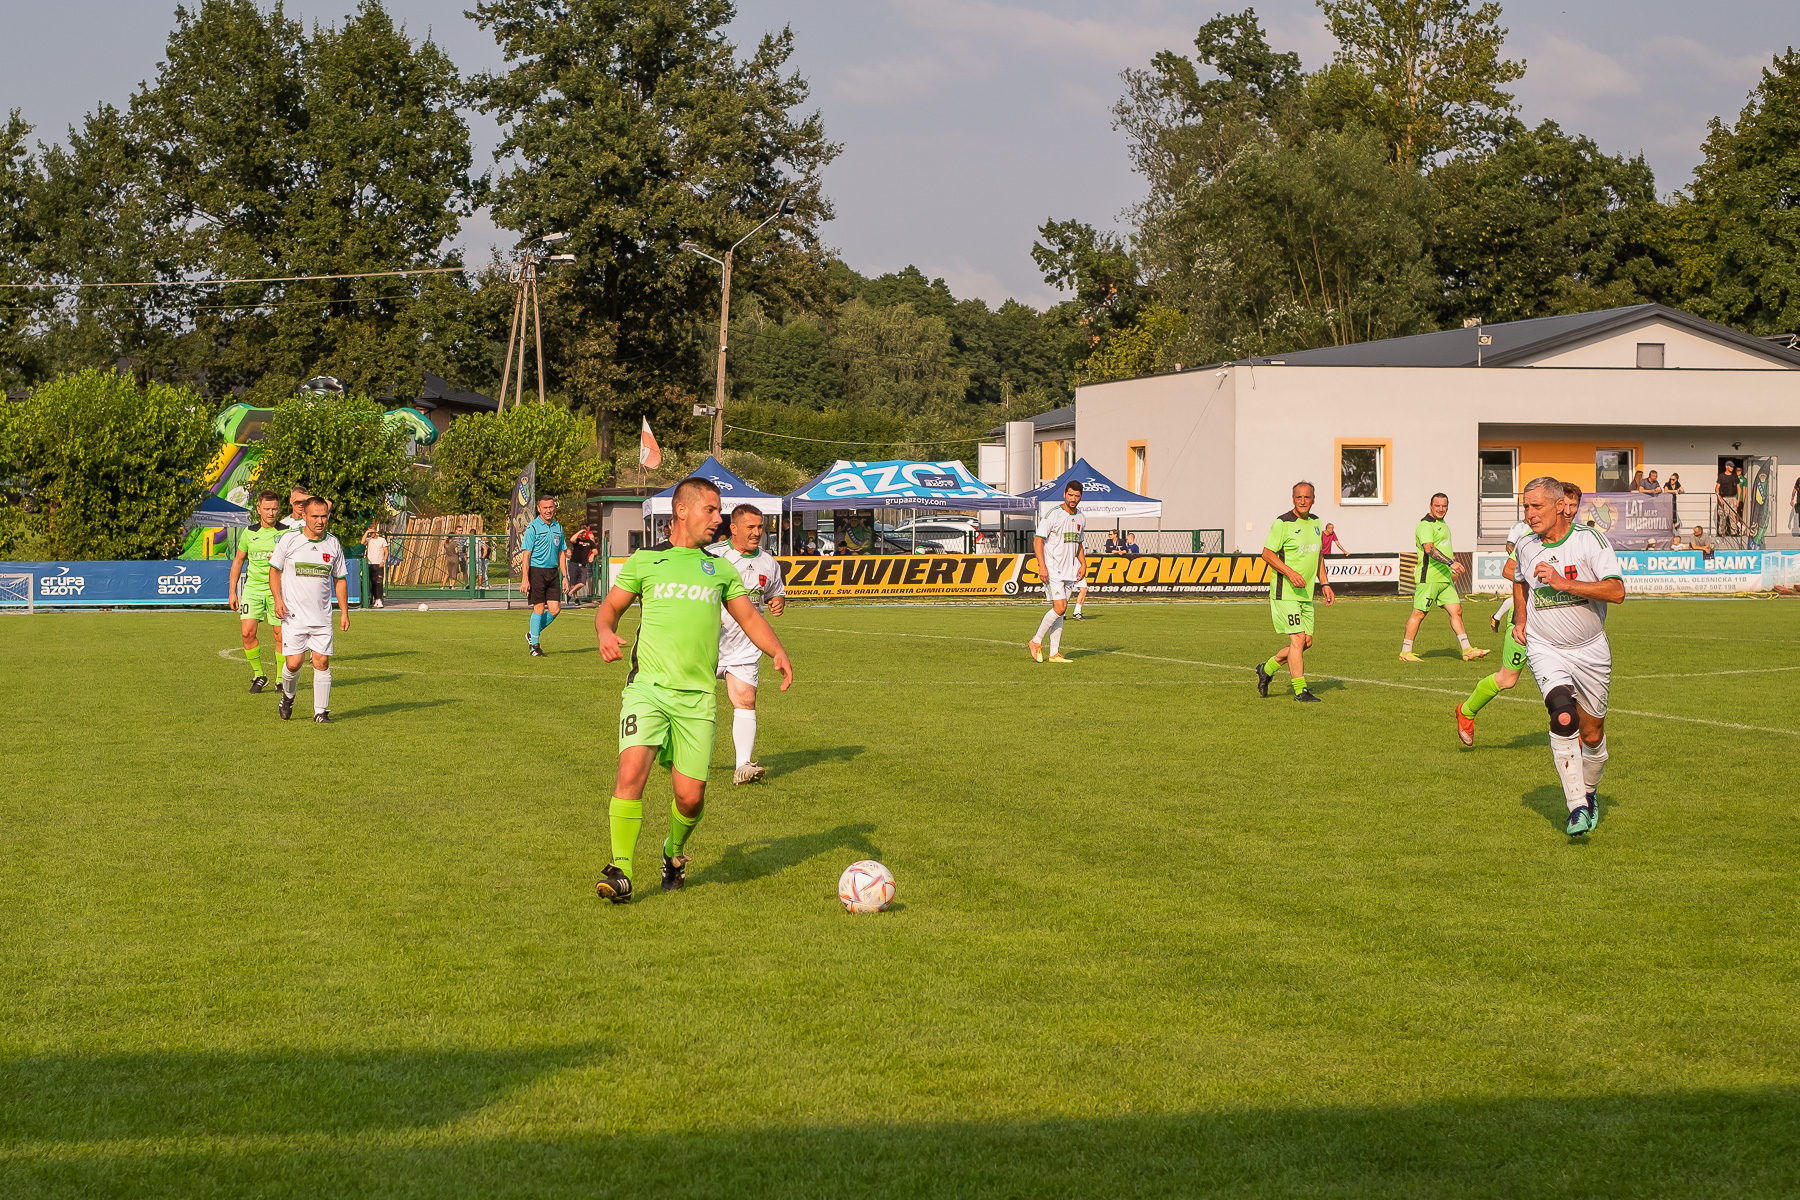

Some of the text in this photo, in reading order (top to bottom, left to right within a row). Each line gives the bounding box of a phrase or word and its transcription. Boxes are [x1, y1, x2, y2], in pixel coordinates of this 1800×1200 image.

[885, 497, 947, 506] grupaazoty.com
[1625, 500, 1644, 517] LAT
[1625, 517, 1668, 532] DĄBROVIA
[1325, 565, 1393, 576] YDROLAND
[1617, 556, 1758, 571] NA DRZWI BRAMY
[780, 557, 1278, 586] RZEWIERTY SEROWAN
[1288, 614, 1301, 626] 86
[620, 714, 638, 738] 18
